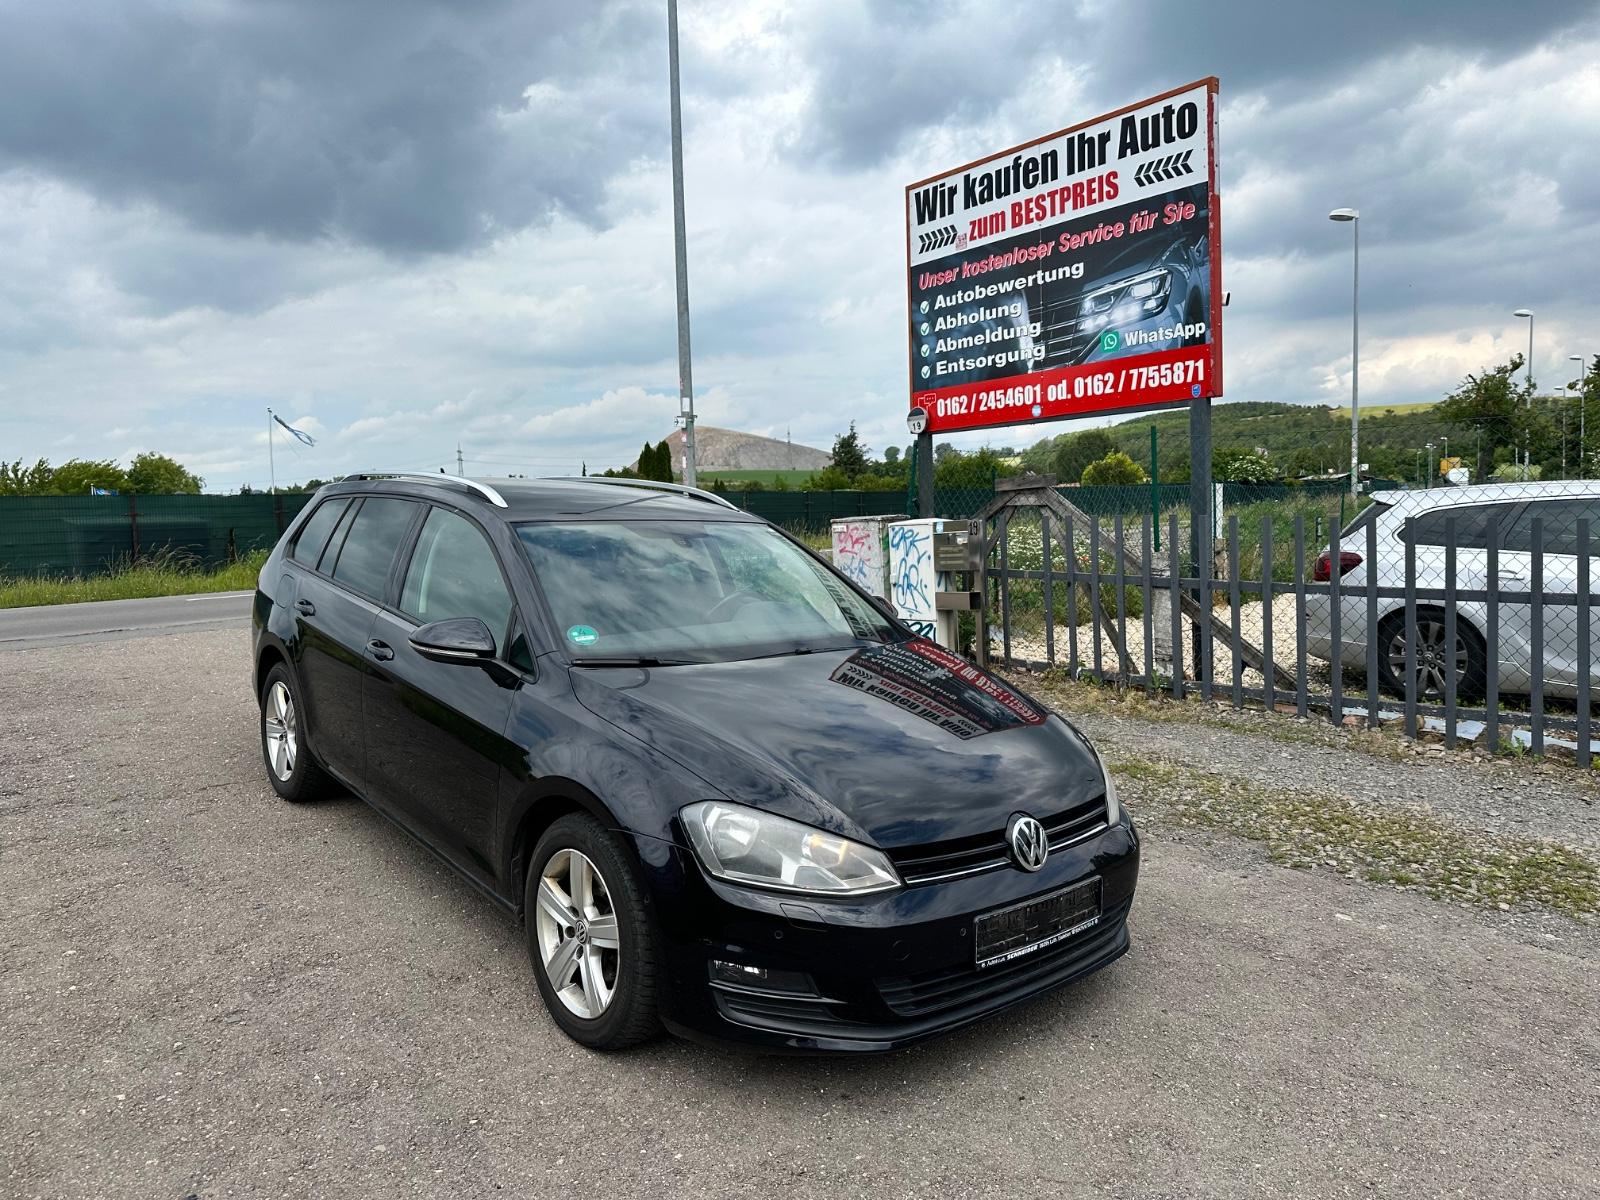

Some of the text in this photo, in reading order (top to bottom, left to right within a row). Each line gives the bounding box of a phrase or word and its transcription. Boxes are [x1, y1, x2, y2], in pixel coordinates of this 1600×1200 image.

[914, 101, 1198, 226] Wir kaufen Ihr Auto
[968, 170, 1119, 242] zum BESTPREIS
[918, 267, 960, 291] Unser
[961, 240, 1056, 279] kostenloser
[1058, 222, 1125, 253] Service
[1129, 210, 1159, 234] für
[1162, 201, 1196, 225] Sie
[934, 262, 1085, 311] Autobewertung
[934, 302, 1023, 332] Abholung
[935, 320, 1042, 354] Abmeldung
[1124, 322, 1206, 347] WhatsApp
[936, 344, 1046, 376] Entsorgung
[936, 358, 1205, 417] 0162 / 2454601 od. 0162 / 7755871
[912, 420, 922, 431] 19
[968, 520, 978, 536] 19
